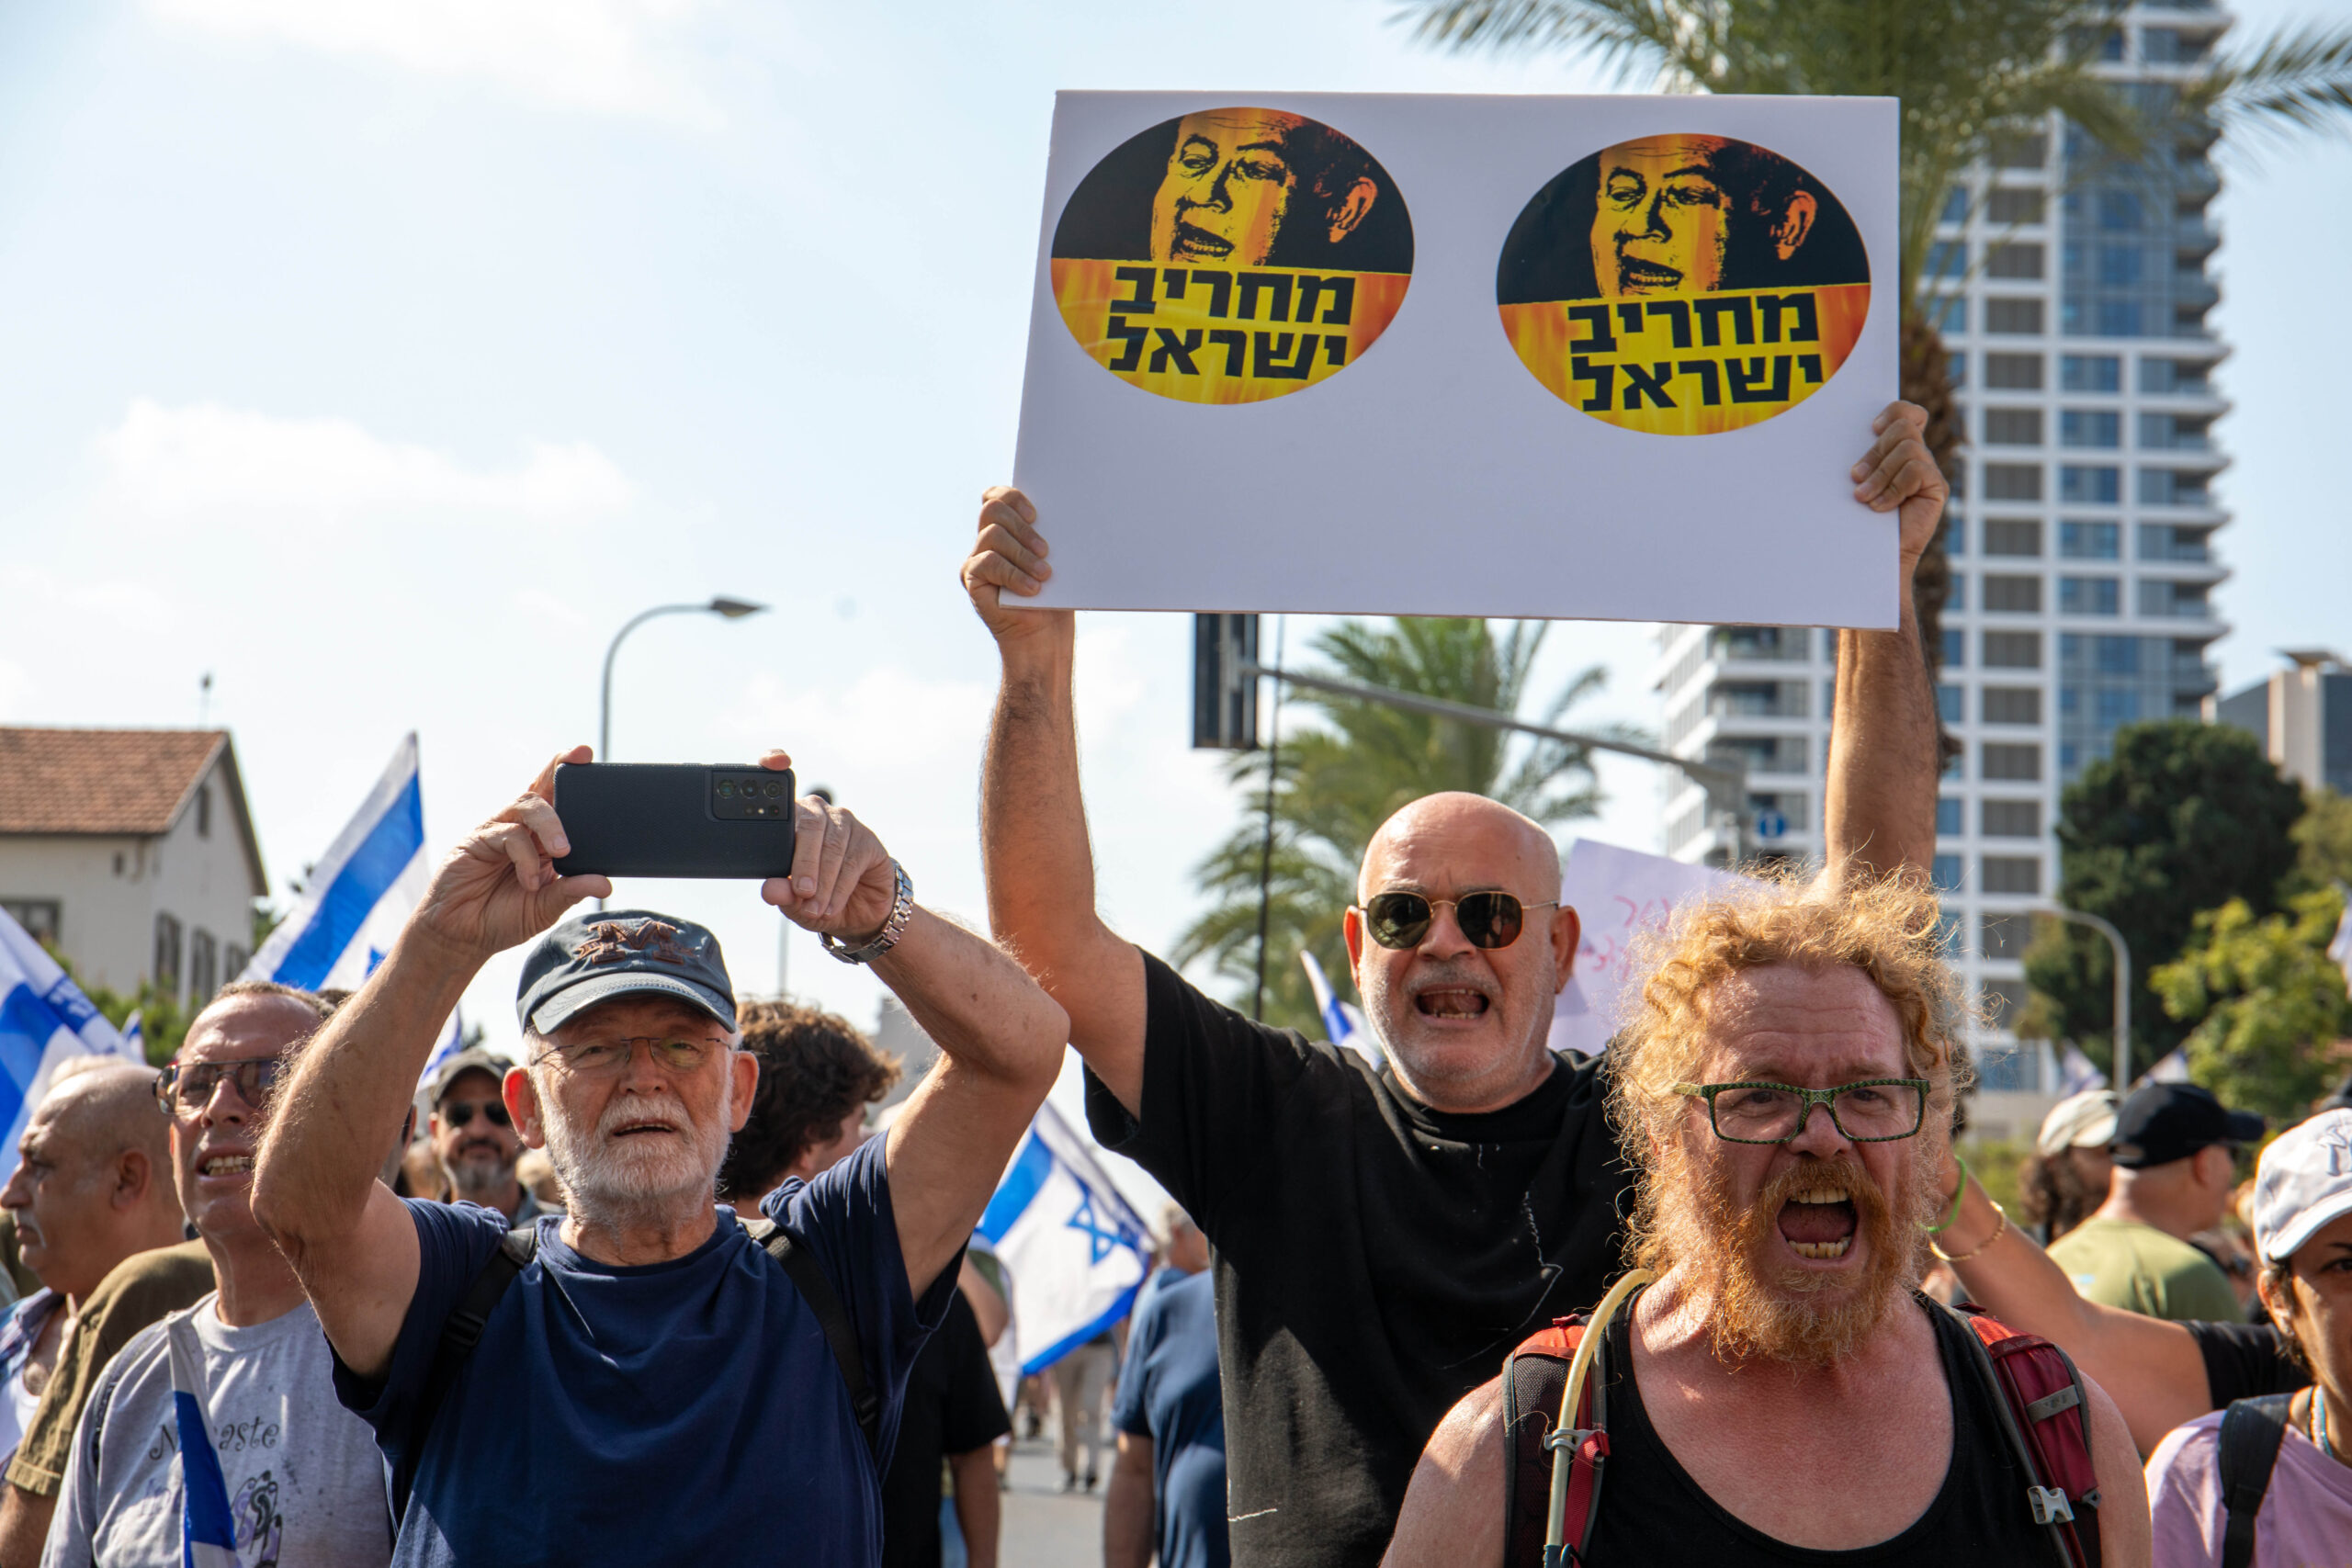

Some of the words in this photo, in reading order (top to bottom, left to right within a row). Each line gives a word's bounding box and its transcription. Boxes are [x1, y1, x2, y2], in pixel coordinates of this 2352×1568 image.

[1110, 266, 1355, 325] מחריב
[1568, 292, 1819, 354] מחריב
[1106, 316, 1347, 380] ישראל
[1571, 354, 1824, 412] ישראל
[149, 1416, 280, 1461] Naste
